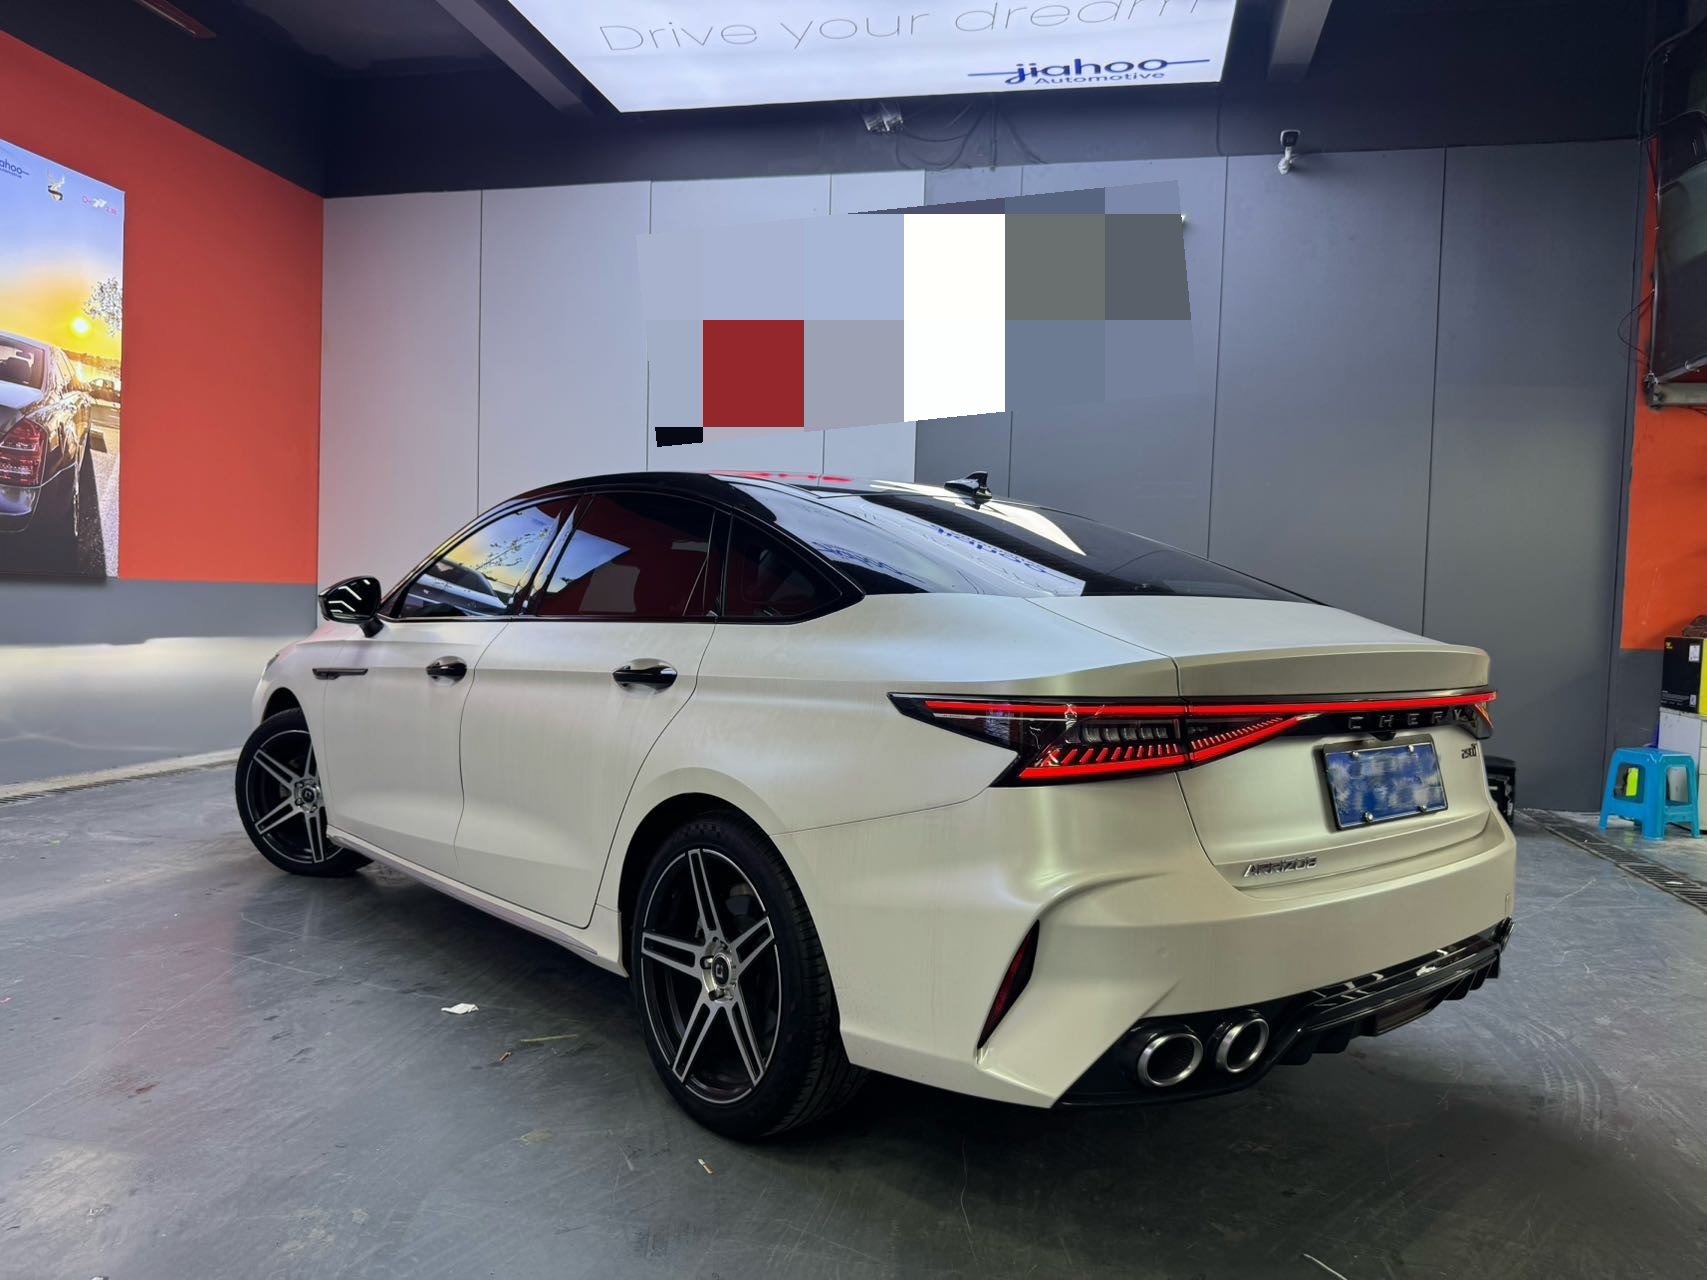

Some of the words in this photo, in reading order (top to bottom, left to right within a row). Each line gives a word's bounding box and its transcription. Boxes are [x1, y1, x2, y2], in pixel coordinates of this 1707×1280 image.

[600, 22, 758, 50] Drive
[780, 13, 930, 49] your
[1003, 58, 1169, 84] jiahoo
[1035, 72, 1166, 84] Automotive
